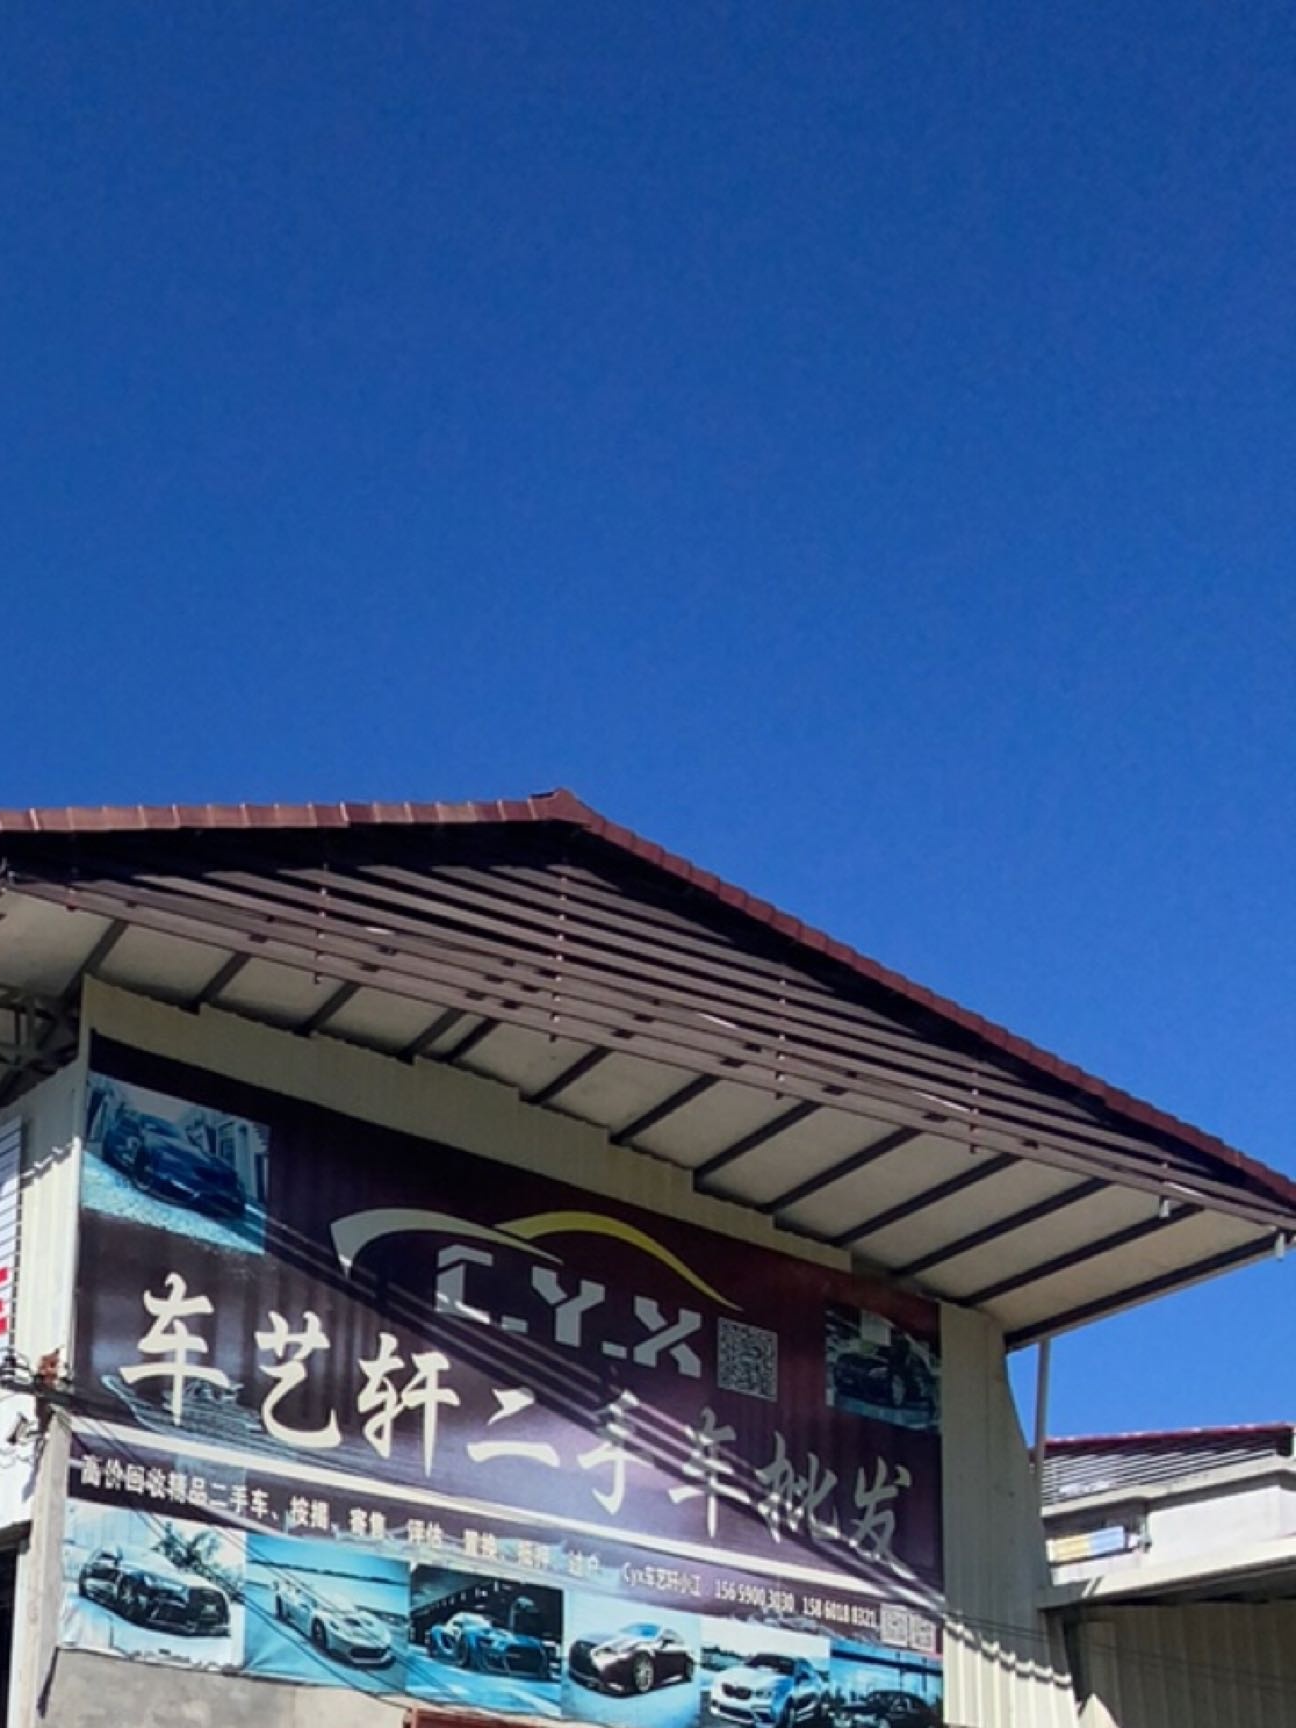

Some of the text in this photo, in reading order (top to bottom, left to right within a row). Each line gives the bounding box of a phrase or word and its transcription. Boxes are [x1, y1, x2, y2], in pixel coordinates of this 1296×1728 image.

[119, 1272, 912, 1567] 车艺轩二手车批发
